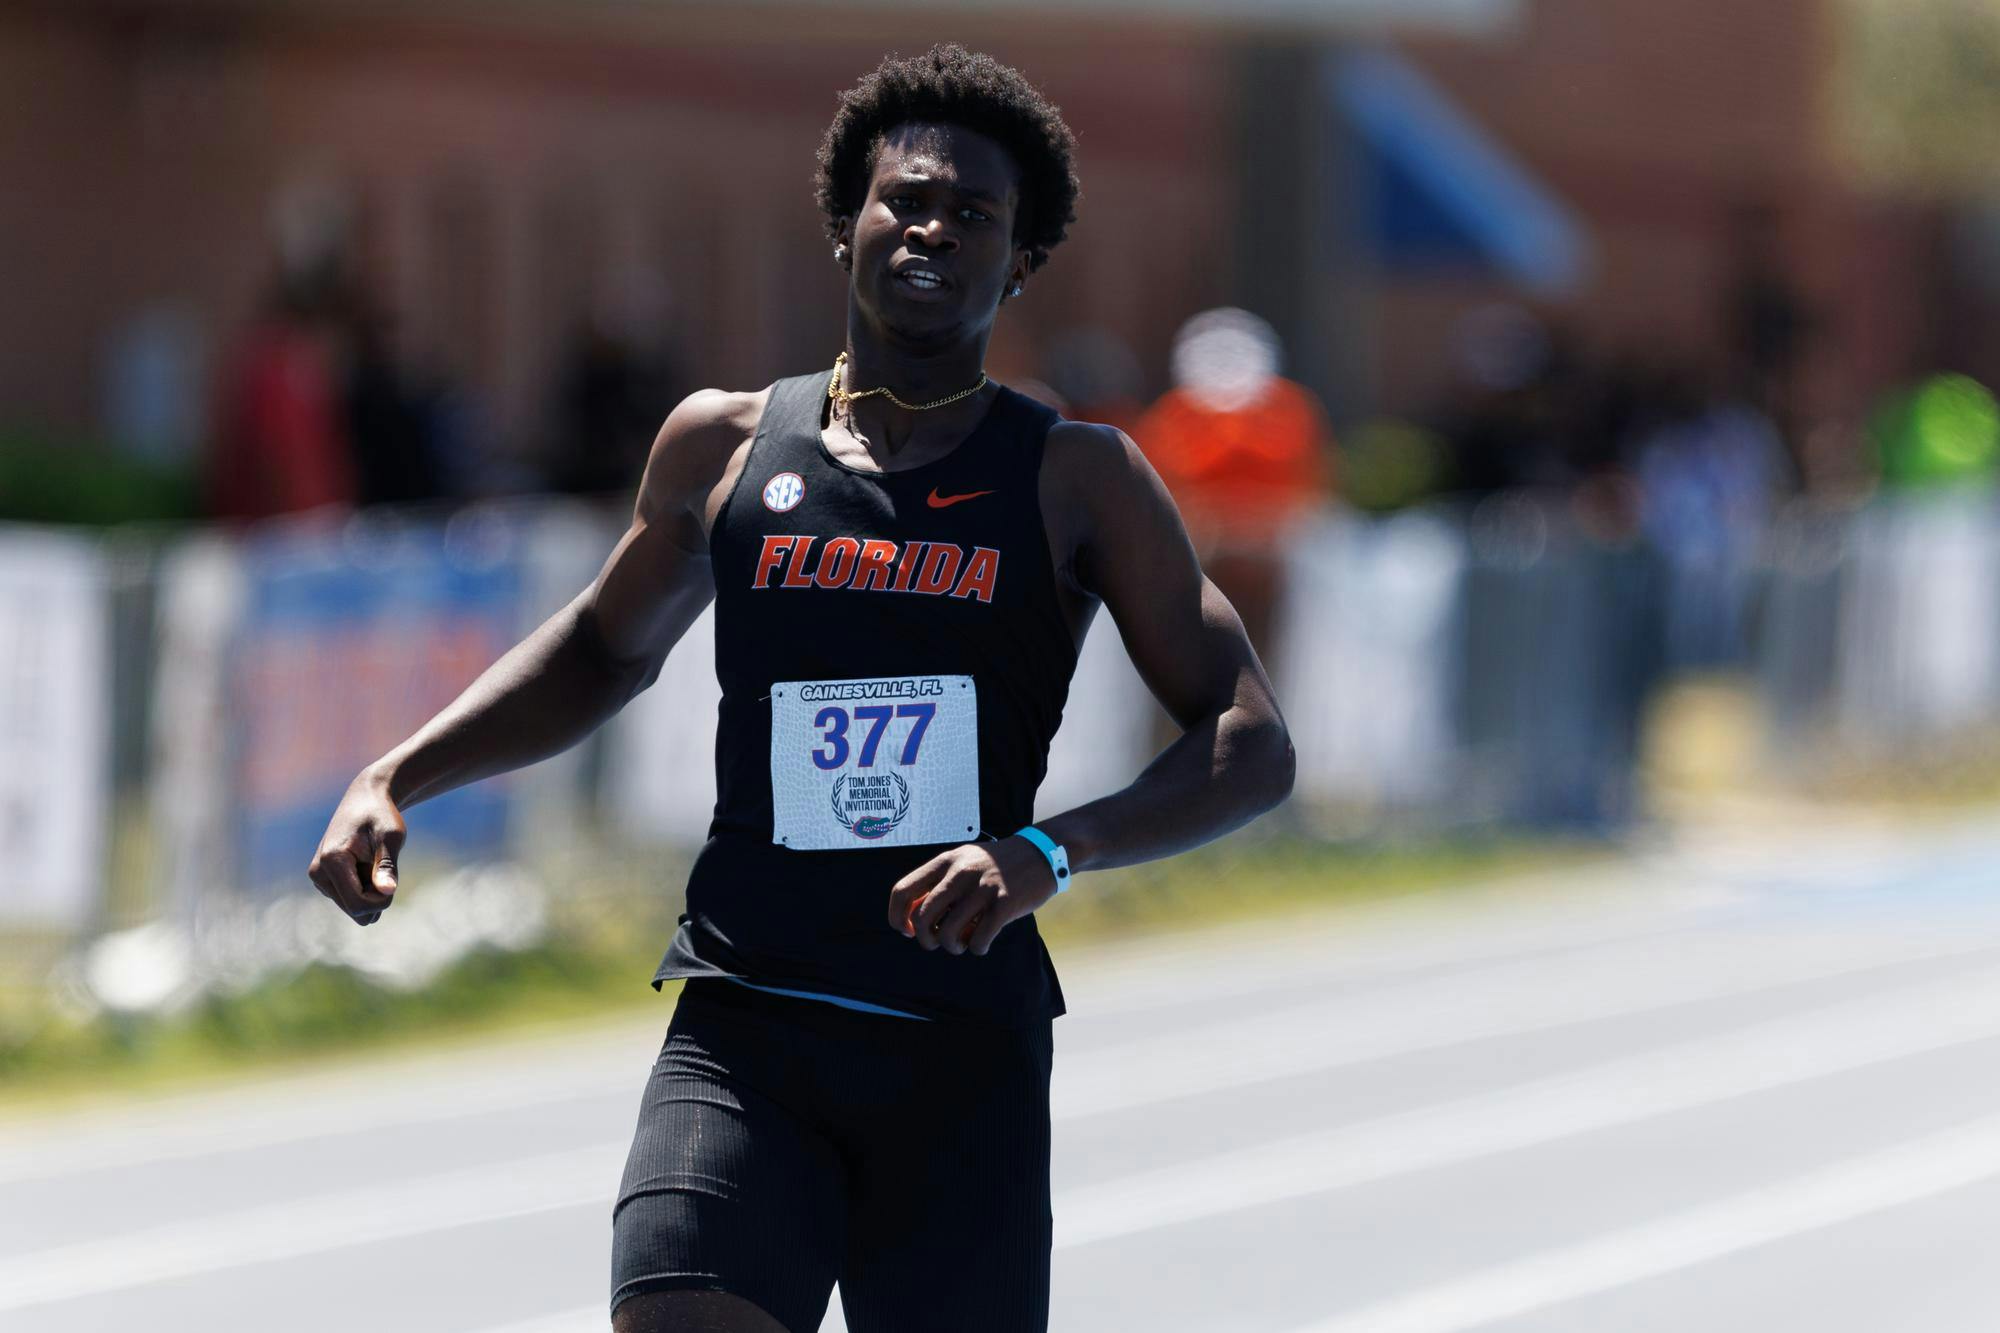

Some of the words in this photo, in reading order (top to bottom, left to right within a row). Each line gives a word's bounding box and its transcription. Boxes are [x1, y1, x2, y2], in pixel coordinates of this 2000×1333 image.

[766, 475, 802, 510] SEC
[751, 535, 1001, 604] FLORIDA
[800, 681, 918, 701] GAINESVILLE,
[919, 679, 944, 696] FL
[811, 702, 937, 771] 377
[848, 776, 865, 788] TOM
[867, 775, 891, 787] JONES
[849, 787, 891, 800] MEMORIAL
[845, 799, 896, 812] INVITATIONAL
